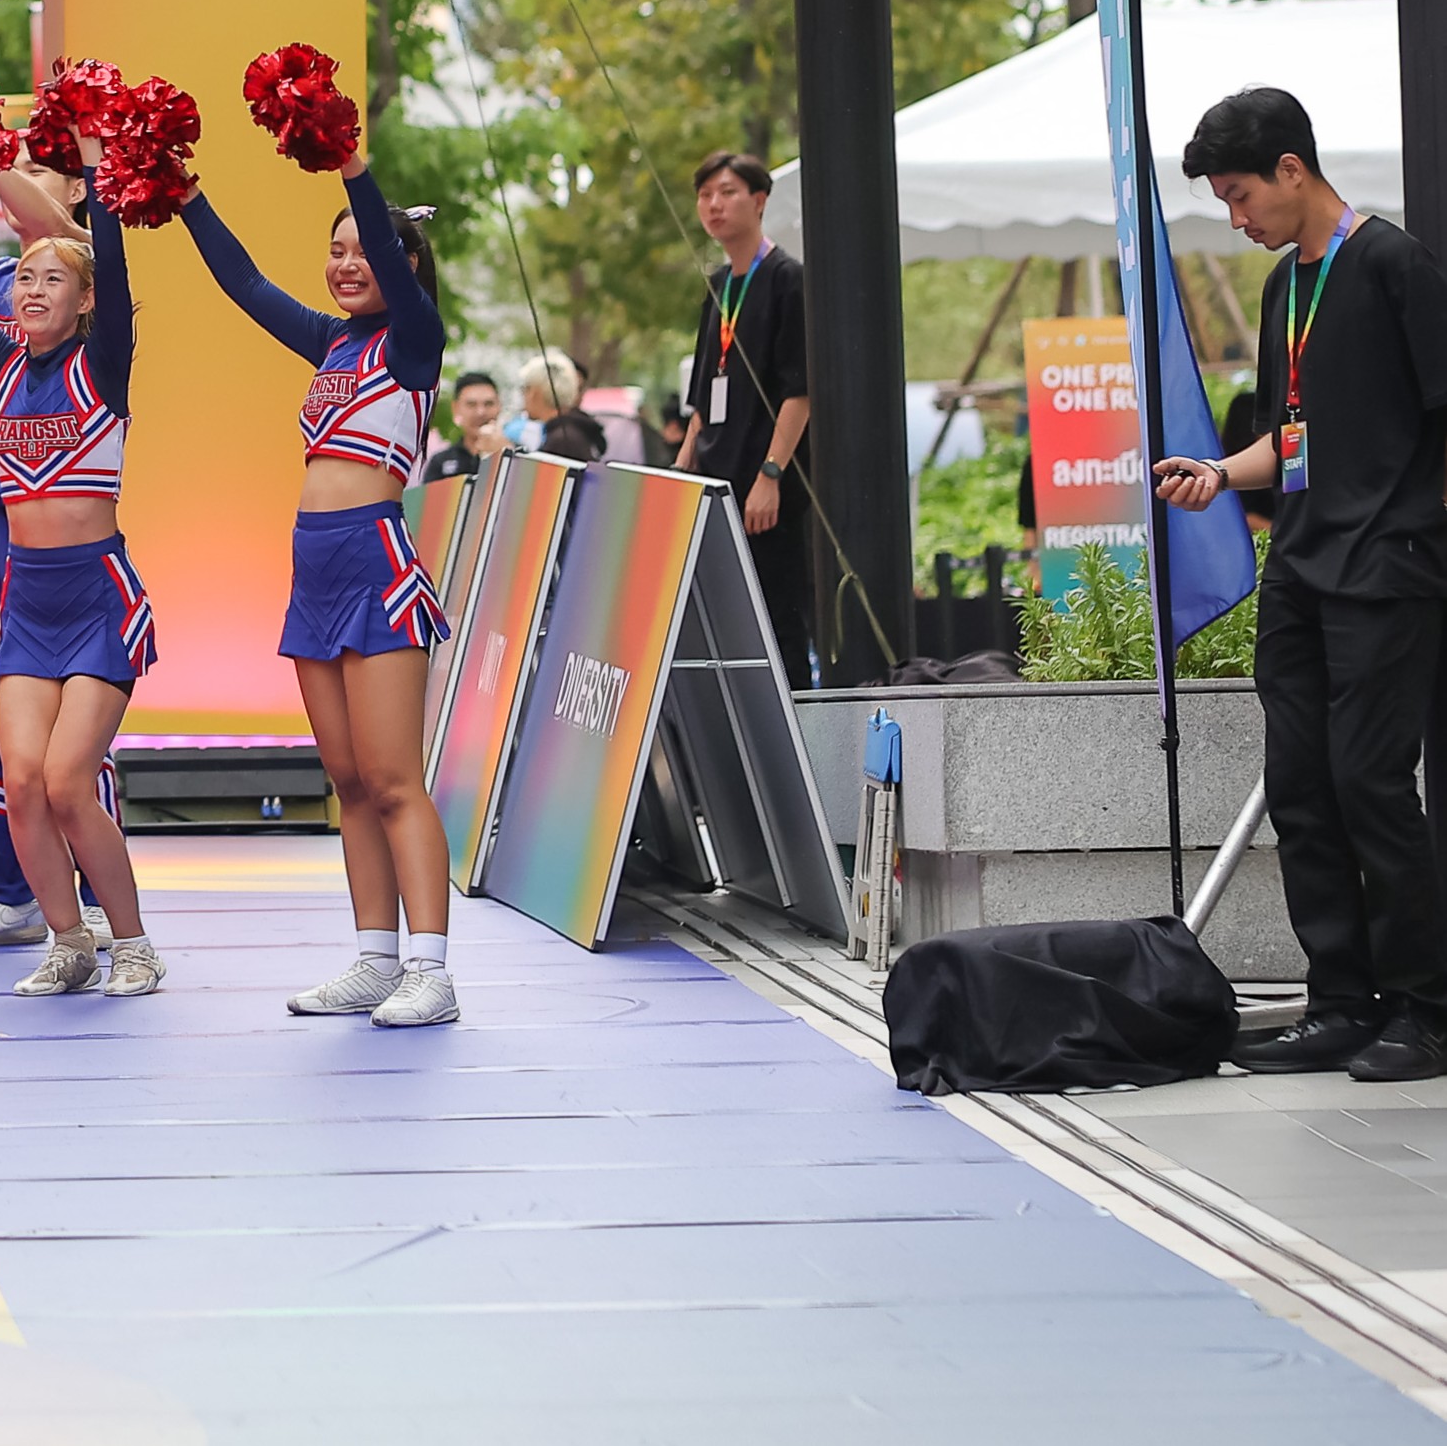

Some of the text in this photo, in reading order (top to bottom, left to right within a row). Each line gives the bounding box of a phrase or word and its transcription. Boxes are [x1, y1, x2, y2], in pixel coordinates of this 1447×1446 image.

[1041, 365, 1096, 388] ONE
[1053, 388, 1106, 412] ONE
[1284, 456, 1304, 471] STAFF
[1043, 522, 1148, 549] REGISTRA
[554, 652, 631, 737] DIVERSITY
